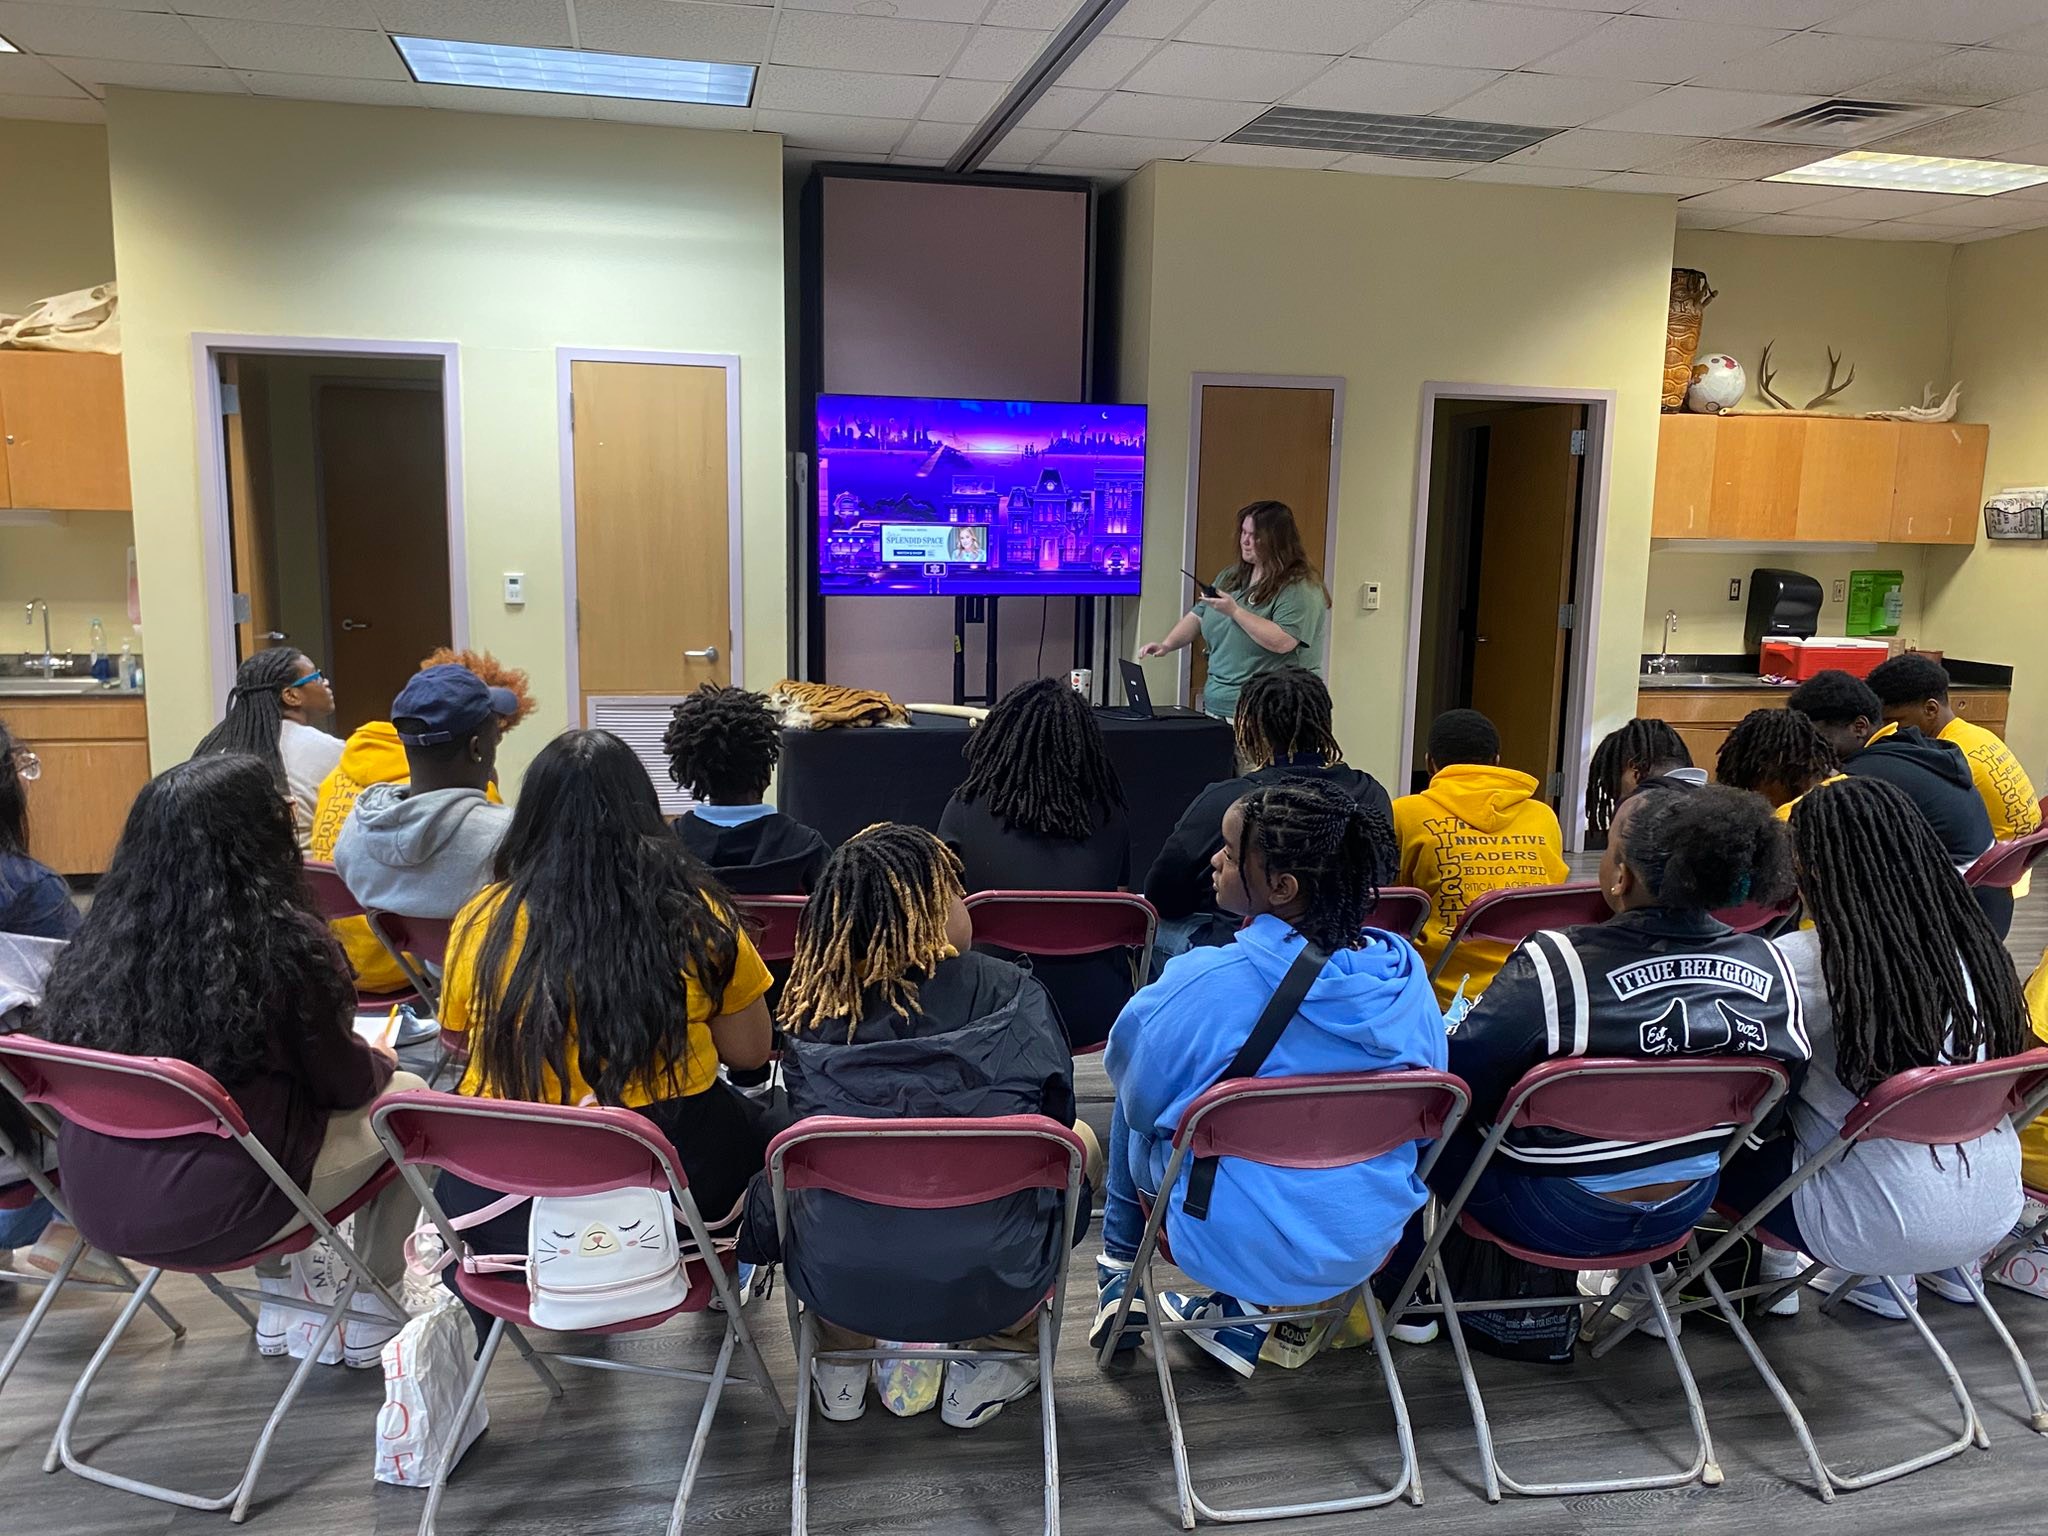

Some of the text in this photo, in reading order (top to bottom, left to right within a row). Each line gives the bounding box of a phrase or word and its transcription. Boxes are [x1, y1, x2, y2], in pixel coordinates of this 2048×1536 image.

[886, 536, 943, 545] SPLENDID SPACE
[1617, 959, 1767, 993] TRUE RELIGION
